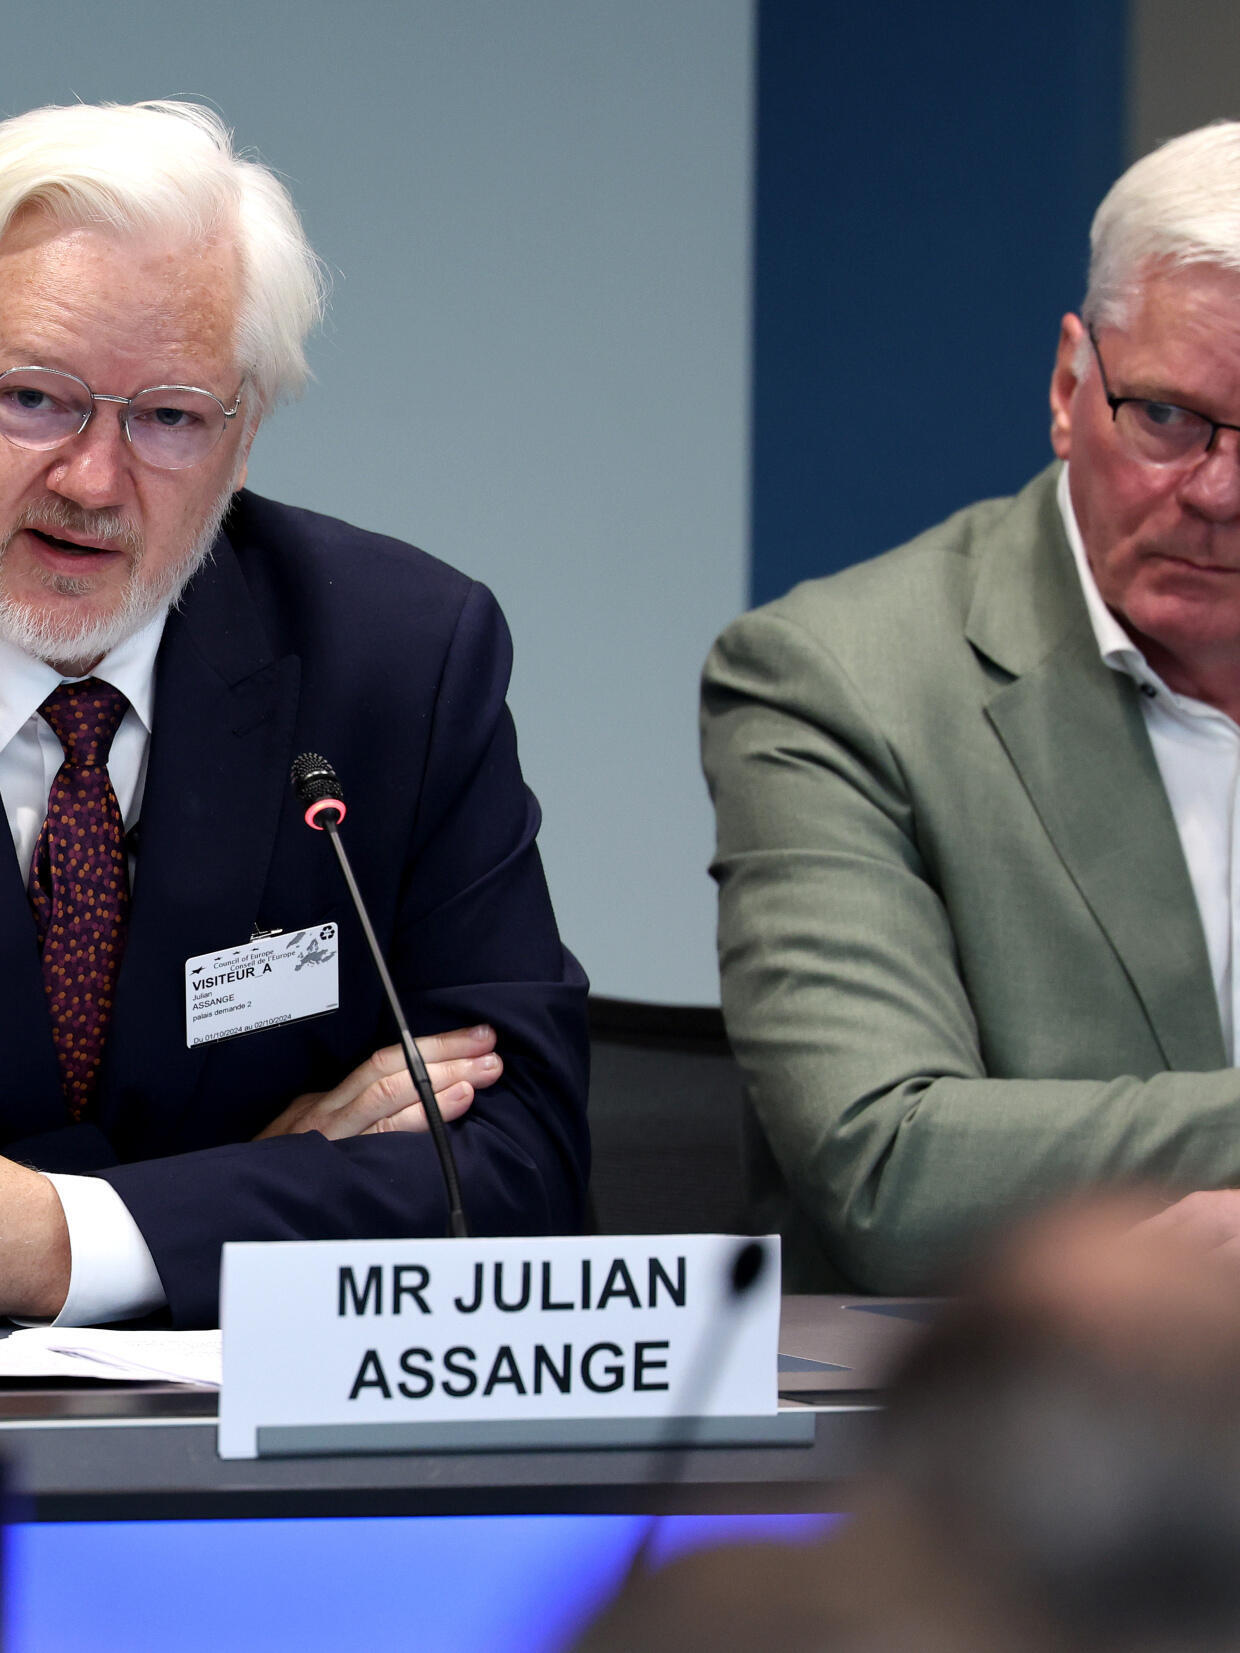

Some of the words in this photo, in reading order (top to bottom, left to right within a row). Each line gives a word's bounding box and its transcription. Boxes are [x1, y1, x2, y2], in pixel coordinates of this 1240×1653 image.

[213, 957, 240, 969] Council
[241, 954, 249, 962] of
[250, 950, 274, 960] Europe
[230, 961, 256, 972] Conseil
[192, 963, 272, 991] VISITEUR_A
[192, 991, 213, 1001] Julian
[192, 994, 235, 1011] ASSANGE
[192, 1010, 213, 1022] palais
[214, 1003, 246, 1016] demande
[204, 1027, 243, 1041] 01/10/2024
[254, 1014, 292, 1029] 02/10/2024
[337, 1264, 432, 1316] MR
[454, 1256, 686, 1314] JULIAN
[348, 1341, 670, 1399] ASSANGE
